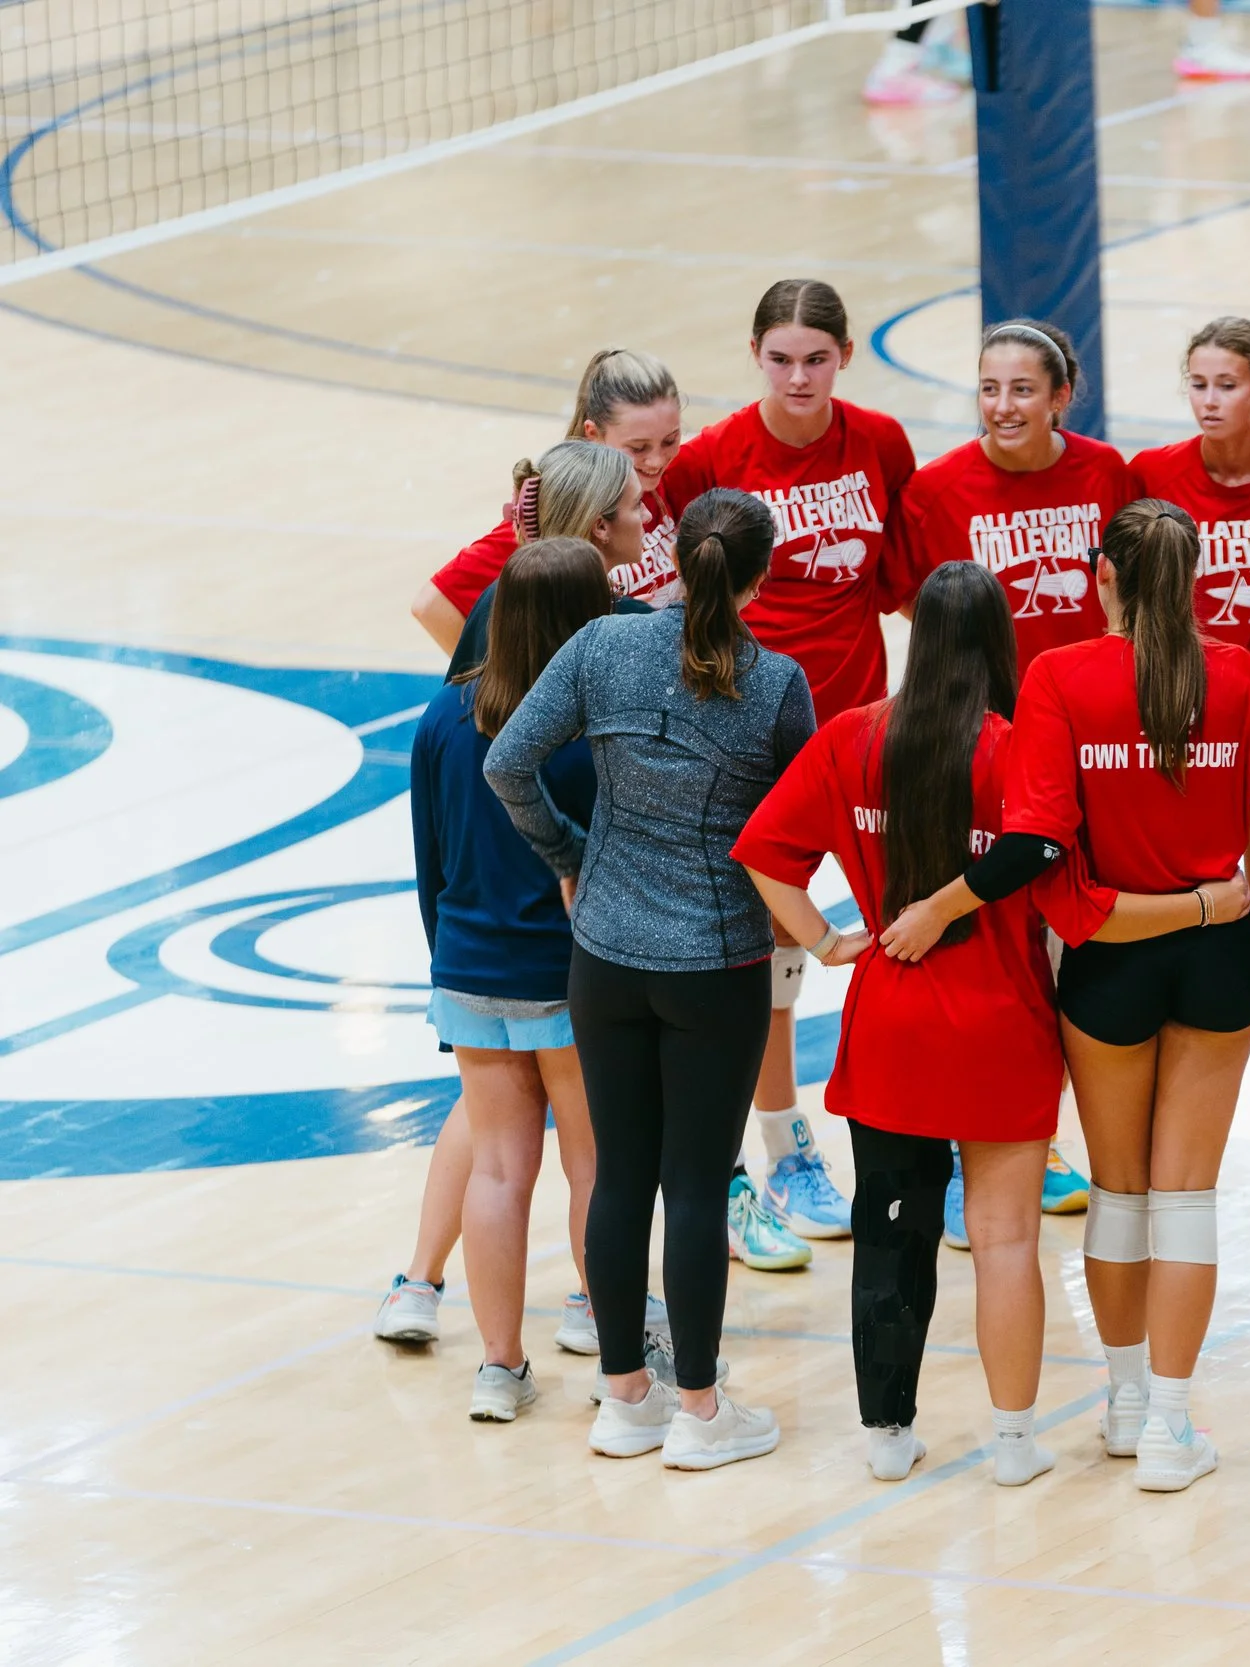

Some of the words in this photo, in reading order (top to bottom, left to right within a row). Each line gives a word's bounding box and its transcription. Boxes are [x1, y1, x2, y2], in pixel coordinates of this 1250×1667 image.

[770, 488, 884, 548] OLLEYBALL
[969, 502, 1101, 535] ALLATOONA
[1080, 743, 1128, 769] OWN
[1184, 742, 1239, 768] COURT
